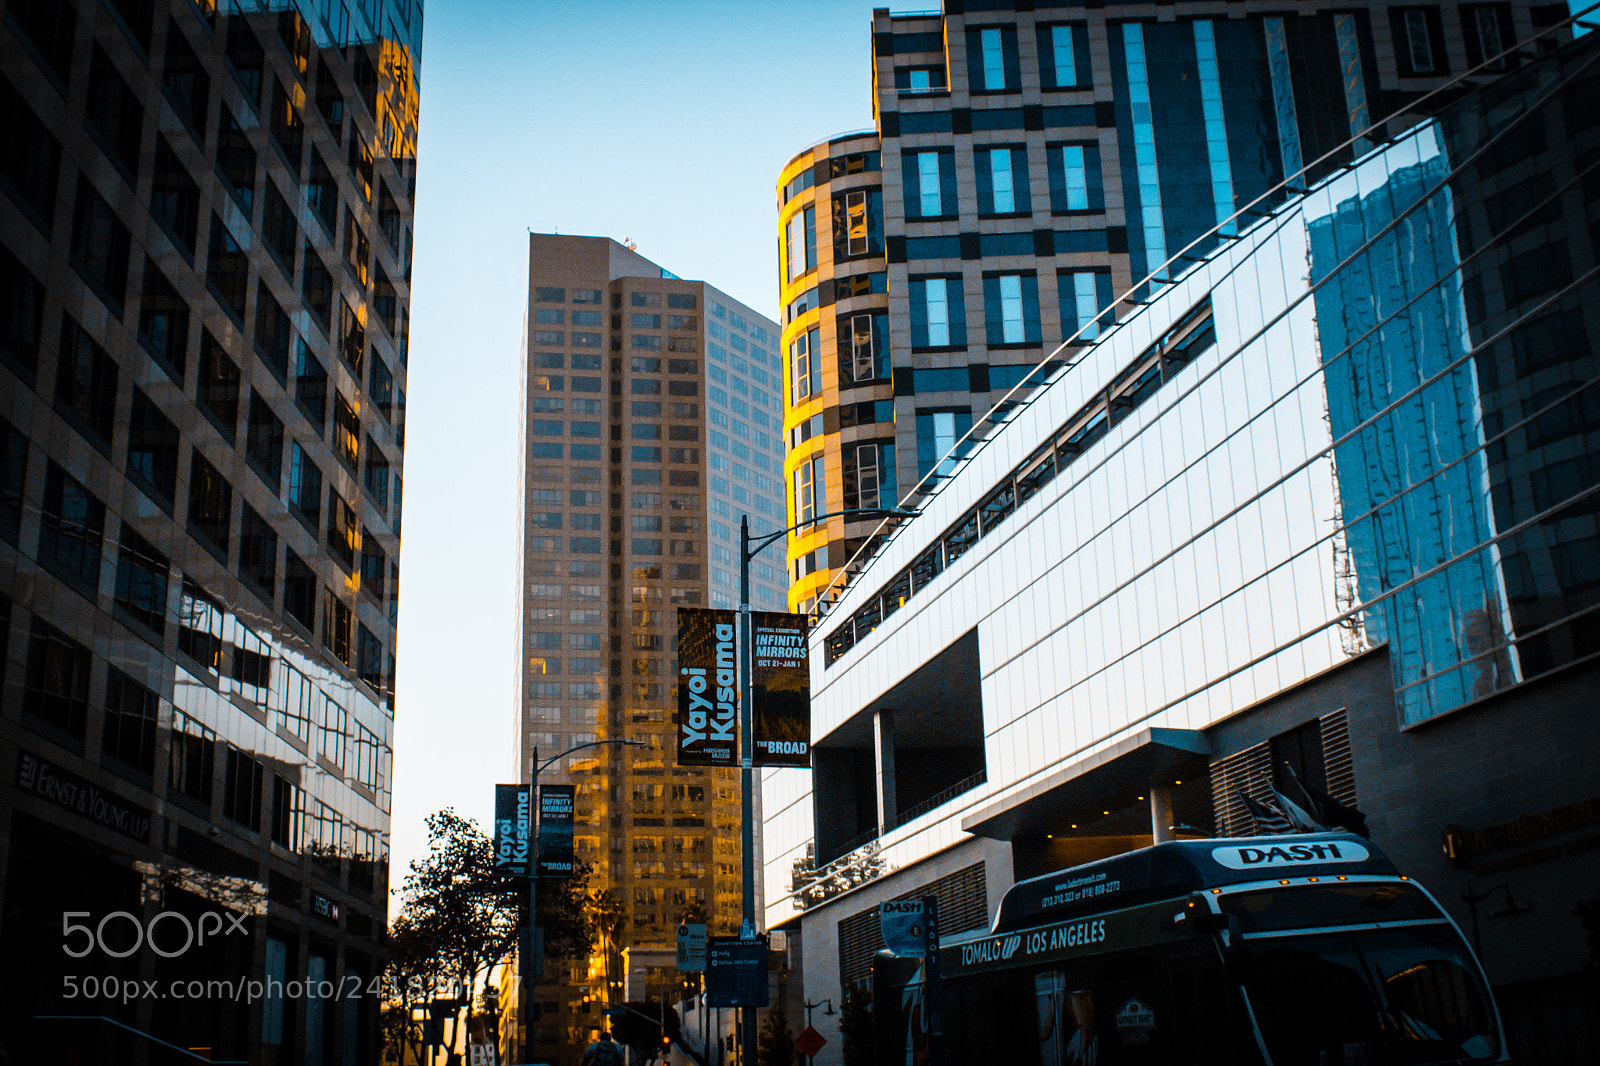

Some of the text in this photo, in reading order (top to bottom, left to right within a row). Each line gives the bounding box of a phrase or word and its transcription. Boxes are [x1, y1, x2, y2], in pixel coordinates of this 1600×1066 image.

[755, 634, 805, 647] INFINITY
[755, 646, 807, 659] MIRRORS
[758, 659, 771, 667] OCT
[710, 623, 735, 741] Kusama
[681, 667, 714, 749] Yayoi
[767, 741, 807, 754] BROAD
[37, 763, 78, 808] ERNST
[512, 791, 529, 863] Kusama
[495, 819, 515, 867] Yayoi
[1238, 843, 1342, 864] DASH
[547, 862, 572, 870] BROAD
[883, 902, 921, 912] DASH
[1025, 931, 1048, 954] LOS
[1049, 919, 1106, 950] ANGELES
